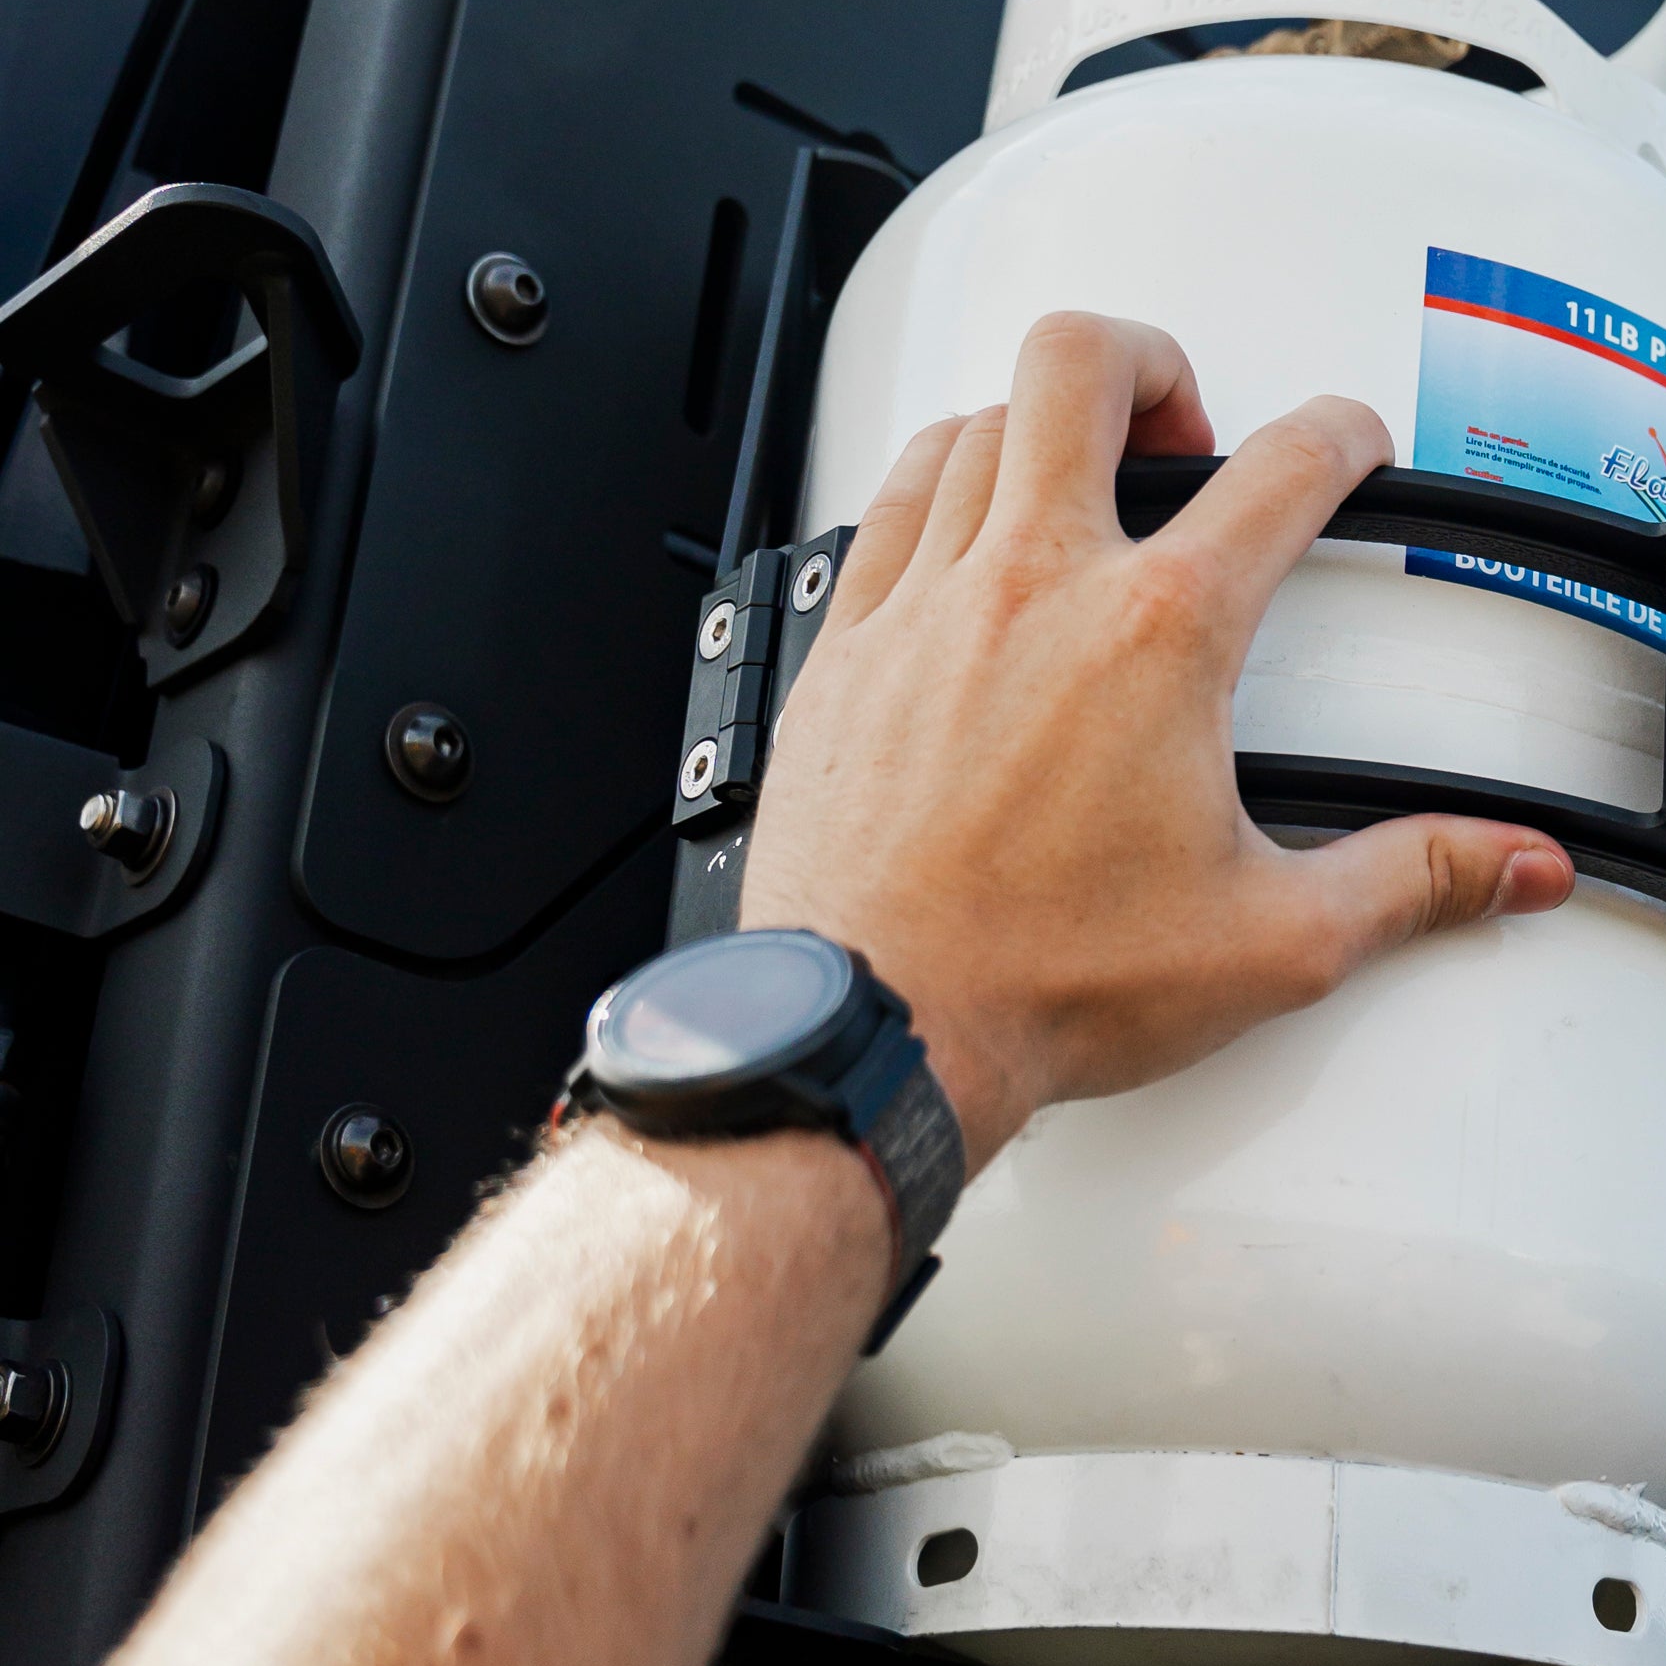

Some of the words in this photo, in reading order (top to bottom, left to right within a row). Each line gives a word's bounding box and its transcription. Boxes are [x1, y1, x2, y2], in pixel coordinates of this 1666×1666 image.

[1566, 300, 1597, 335] 11
[1603, 314, 1640, 352] LB
[1465, 448, 1490, 460] avant
[1491, 453, 1503, 463] de
[1503, 457, 1535, 471] remplir
[1535, 466, 1555, 478] avec
[1555, 472, 1566, 482] du
[1567, 477, 1602, 495] propane.
[1466, 436, 1483, 447] Lire
[1484, 440, 1496, 450] les
[1497, 443, 1547, 465] instructions
[1548, 459, 1559, 469] de
[1559, 464, 1591, 480] sécurité
[1628, 599, 1663, 634] DE
